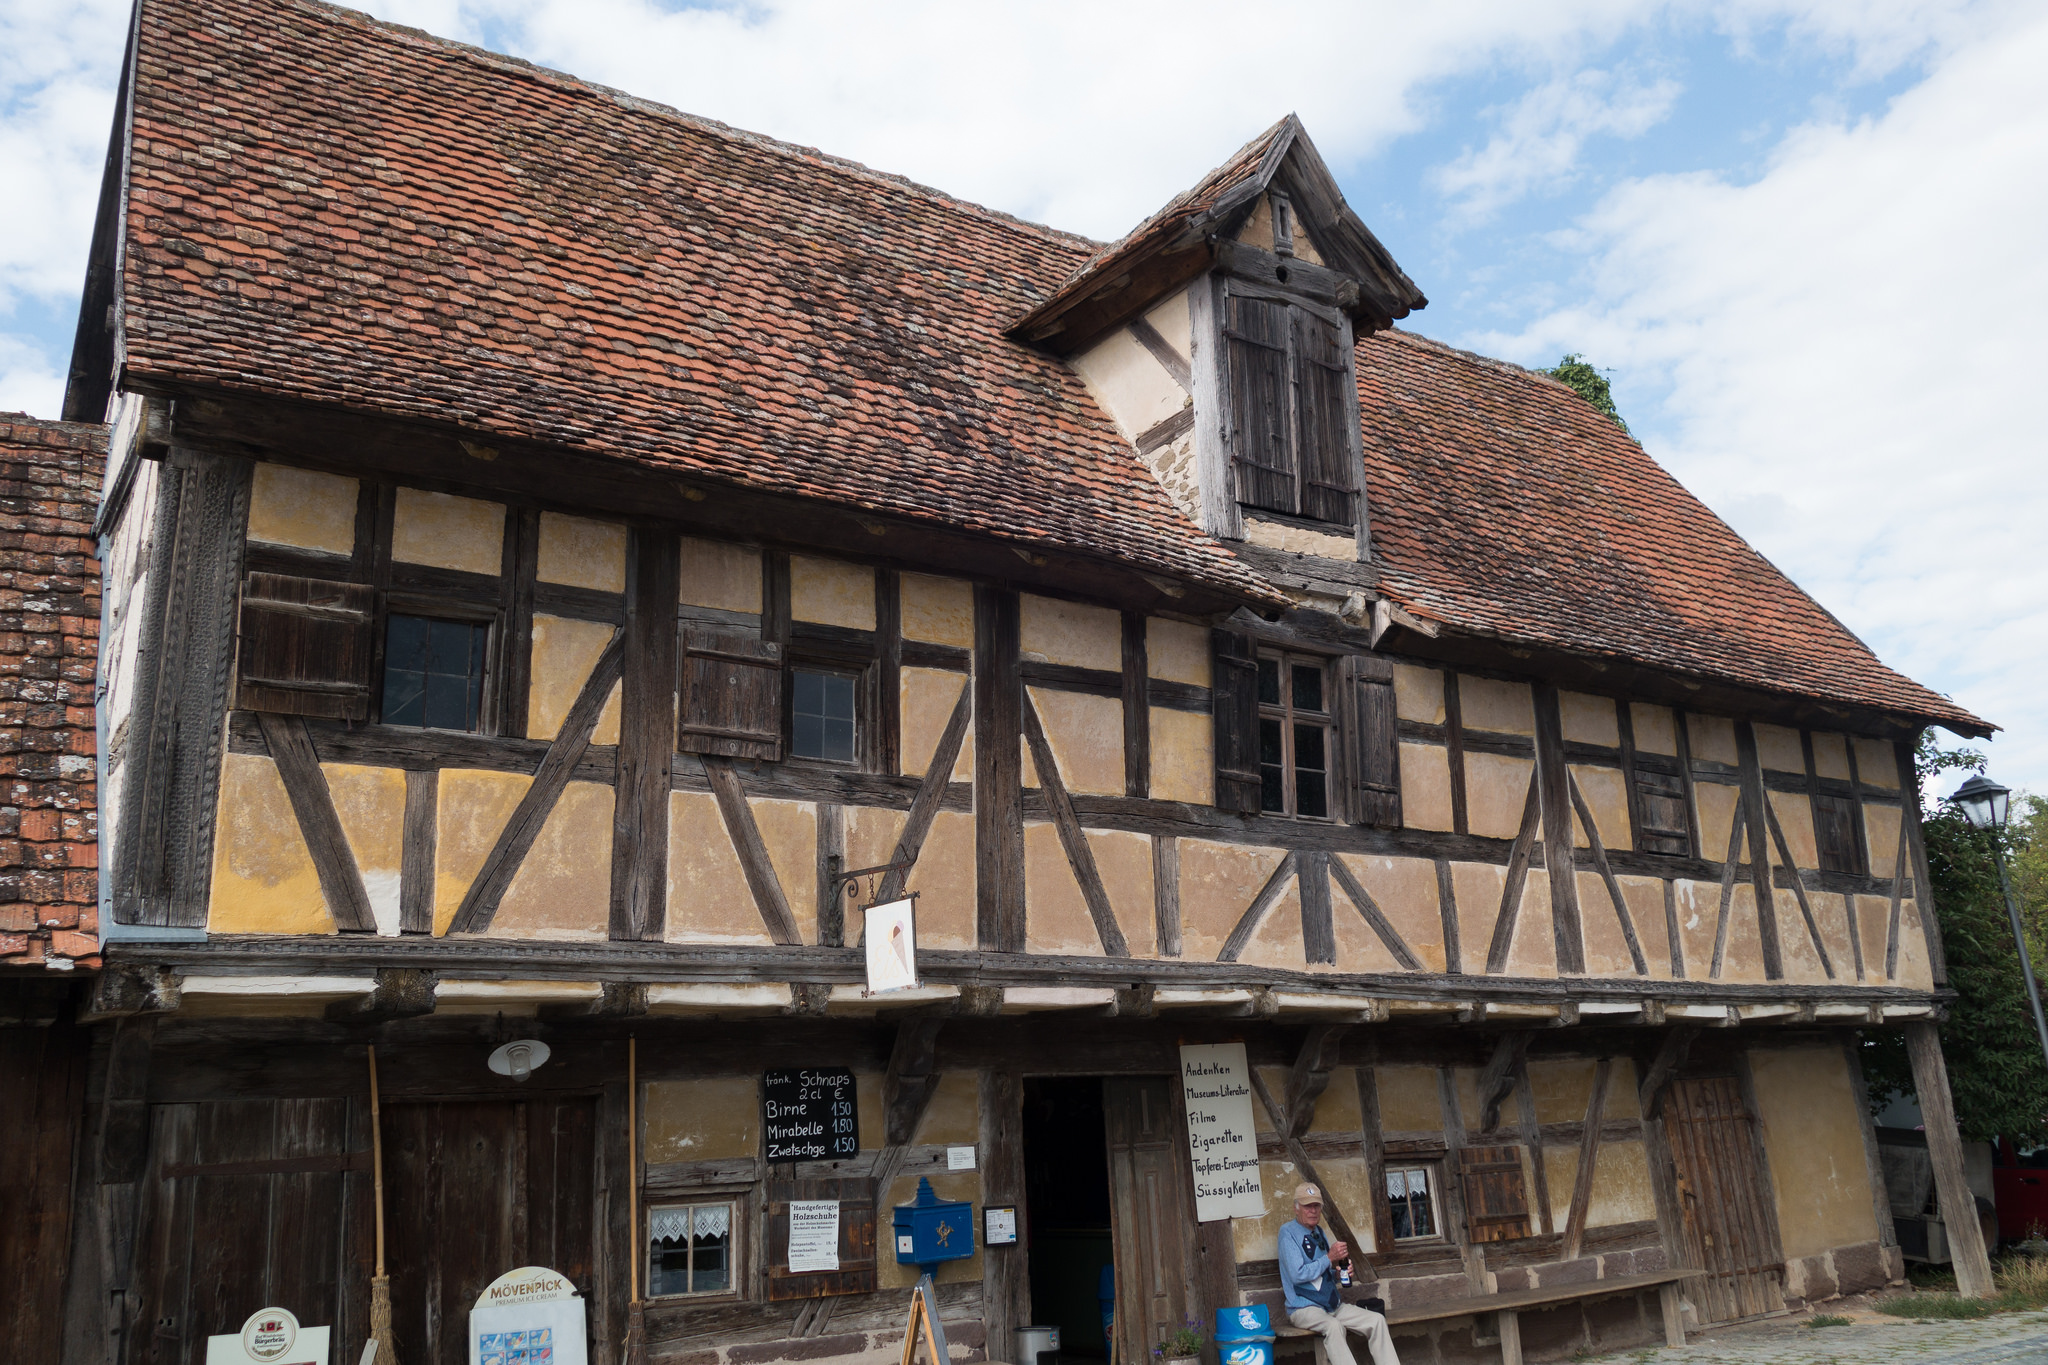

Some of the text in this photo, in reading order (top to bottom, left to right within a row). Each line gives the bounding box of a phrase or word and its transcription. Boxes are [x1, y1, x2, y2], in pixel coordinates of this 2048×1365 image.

[799, 1070, 850, 1087] Schnaps
[799, 1087, 845, 1100] 2 cl €
[1186, 1084, 1250, 1099] Museums-Literatur
[766, 1100, 851, 1118] Birne 1.50
[1188, 1111, 1217, 1126] Filme
[767, 1118, 853, 1139] Mirabelle 1.80
[768, 1137, 855, 1158] Zwetschge 1.50
[1192, 1129, 1243, 1152] Zigaretten
[793, 1212, 837, 1220] Holzschuhe
[490, 1279, 562, 1299] MÖVENPICK
[495, 1297, 525, 1306] PREMIUM
[535, 1293, 558, 1301] CREAM
